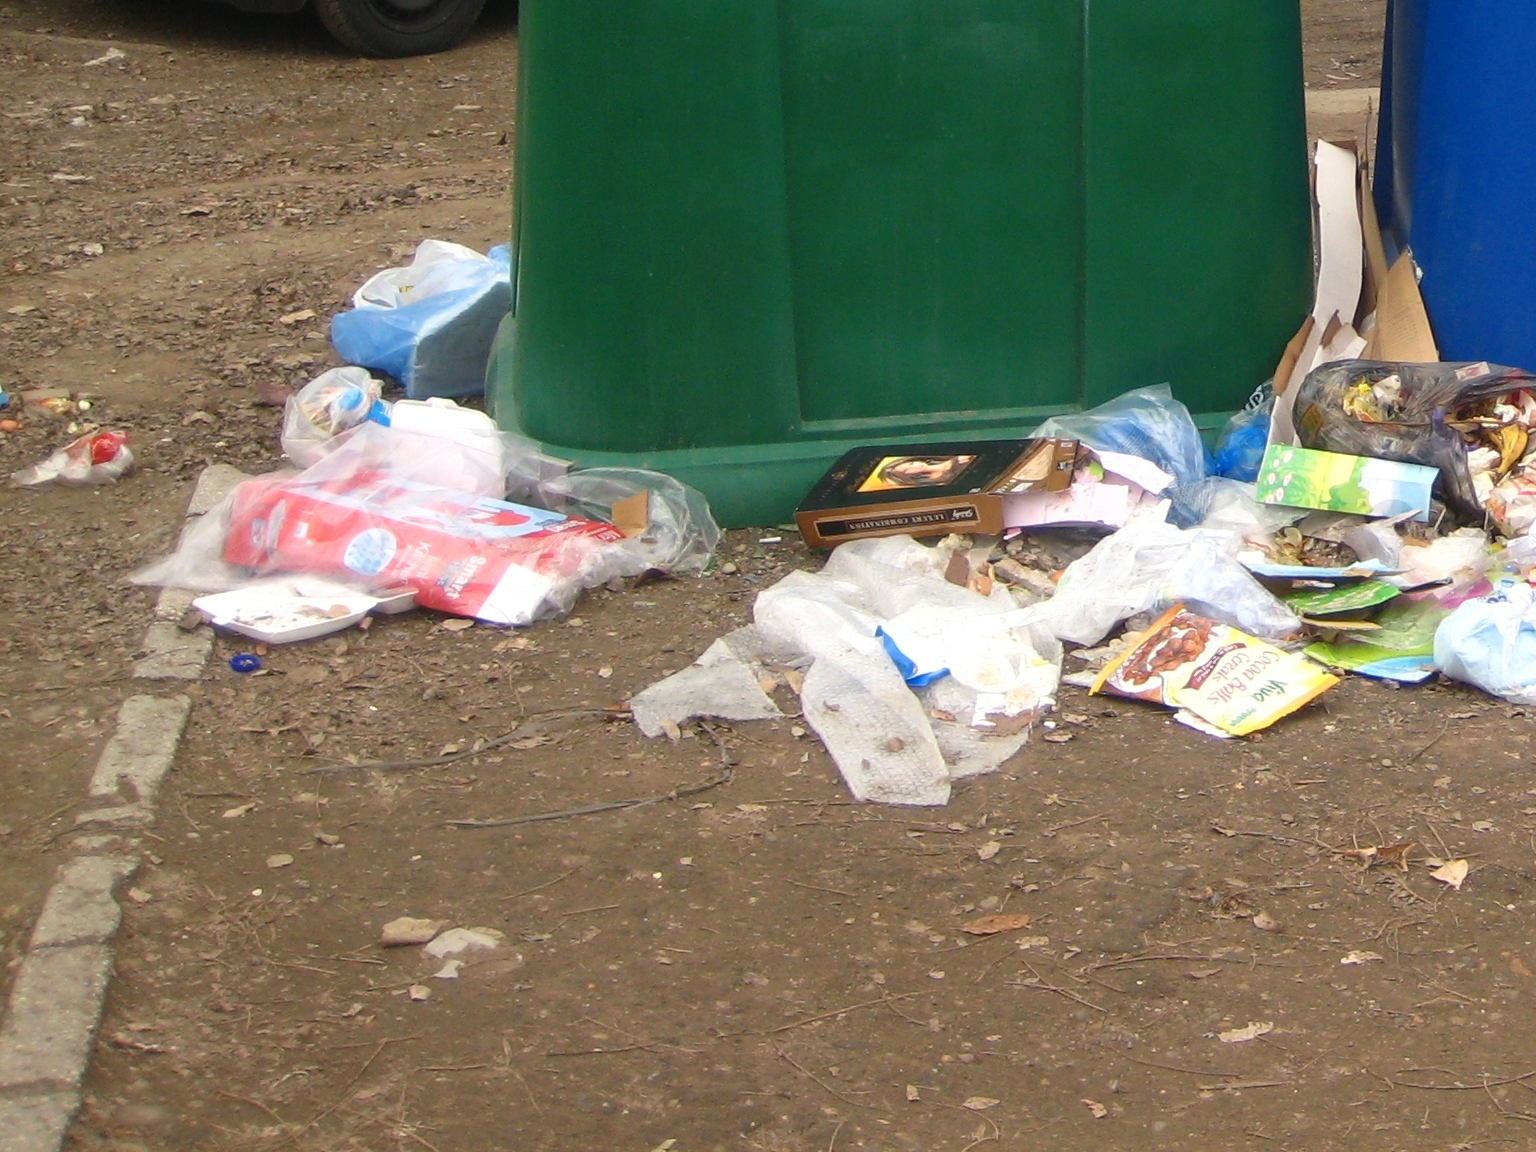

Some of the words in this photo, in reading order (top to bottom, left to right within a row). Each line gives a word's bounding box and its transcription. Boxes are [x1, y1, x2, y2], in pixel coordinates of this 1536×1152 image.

[848, 518, 909, 529] COMBINATION
[443, 555, 487, 599] Smart
[1212, 653, 1250, 682] Cereals
[1242, 651, 1280, 681] Cocoa
[1207, 677, 1247, 705] Balls
